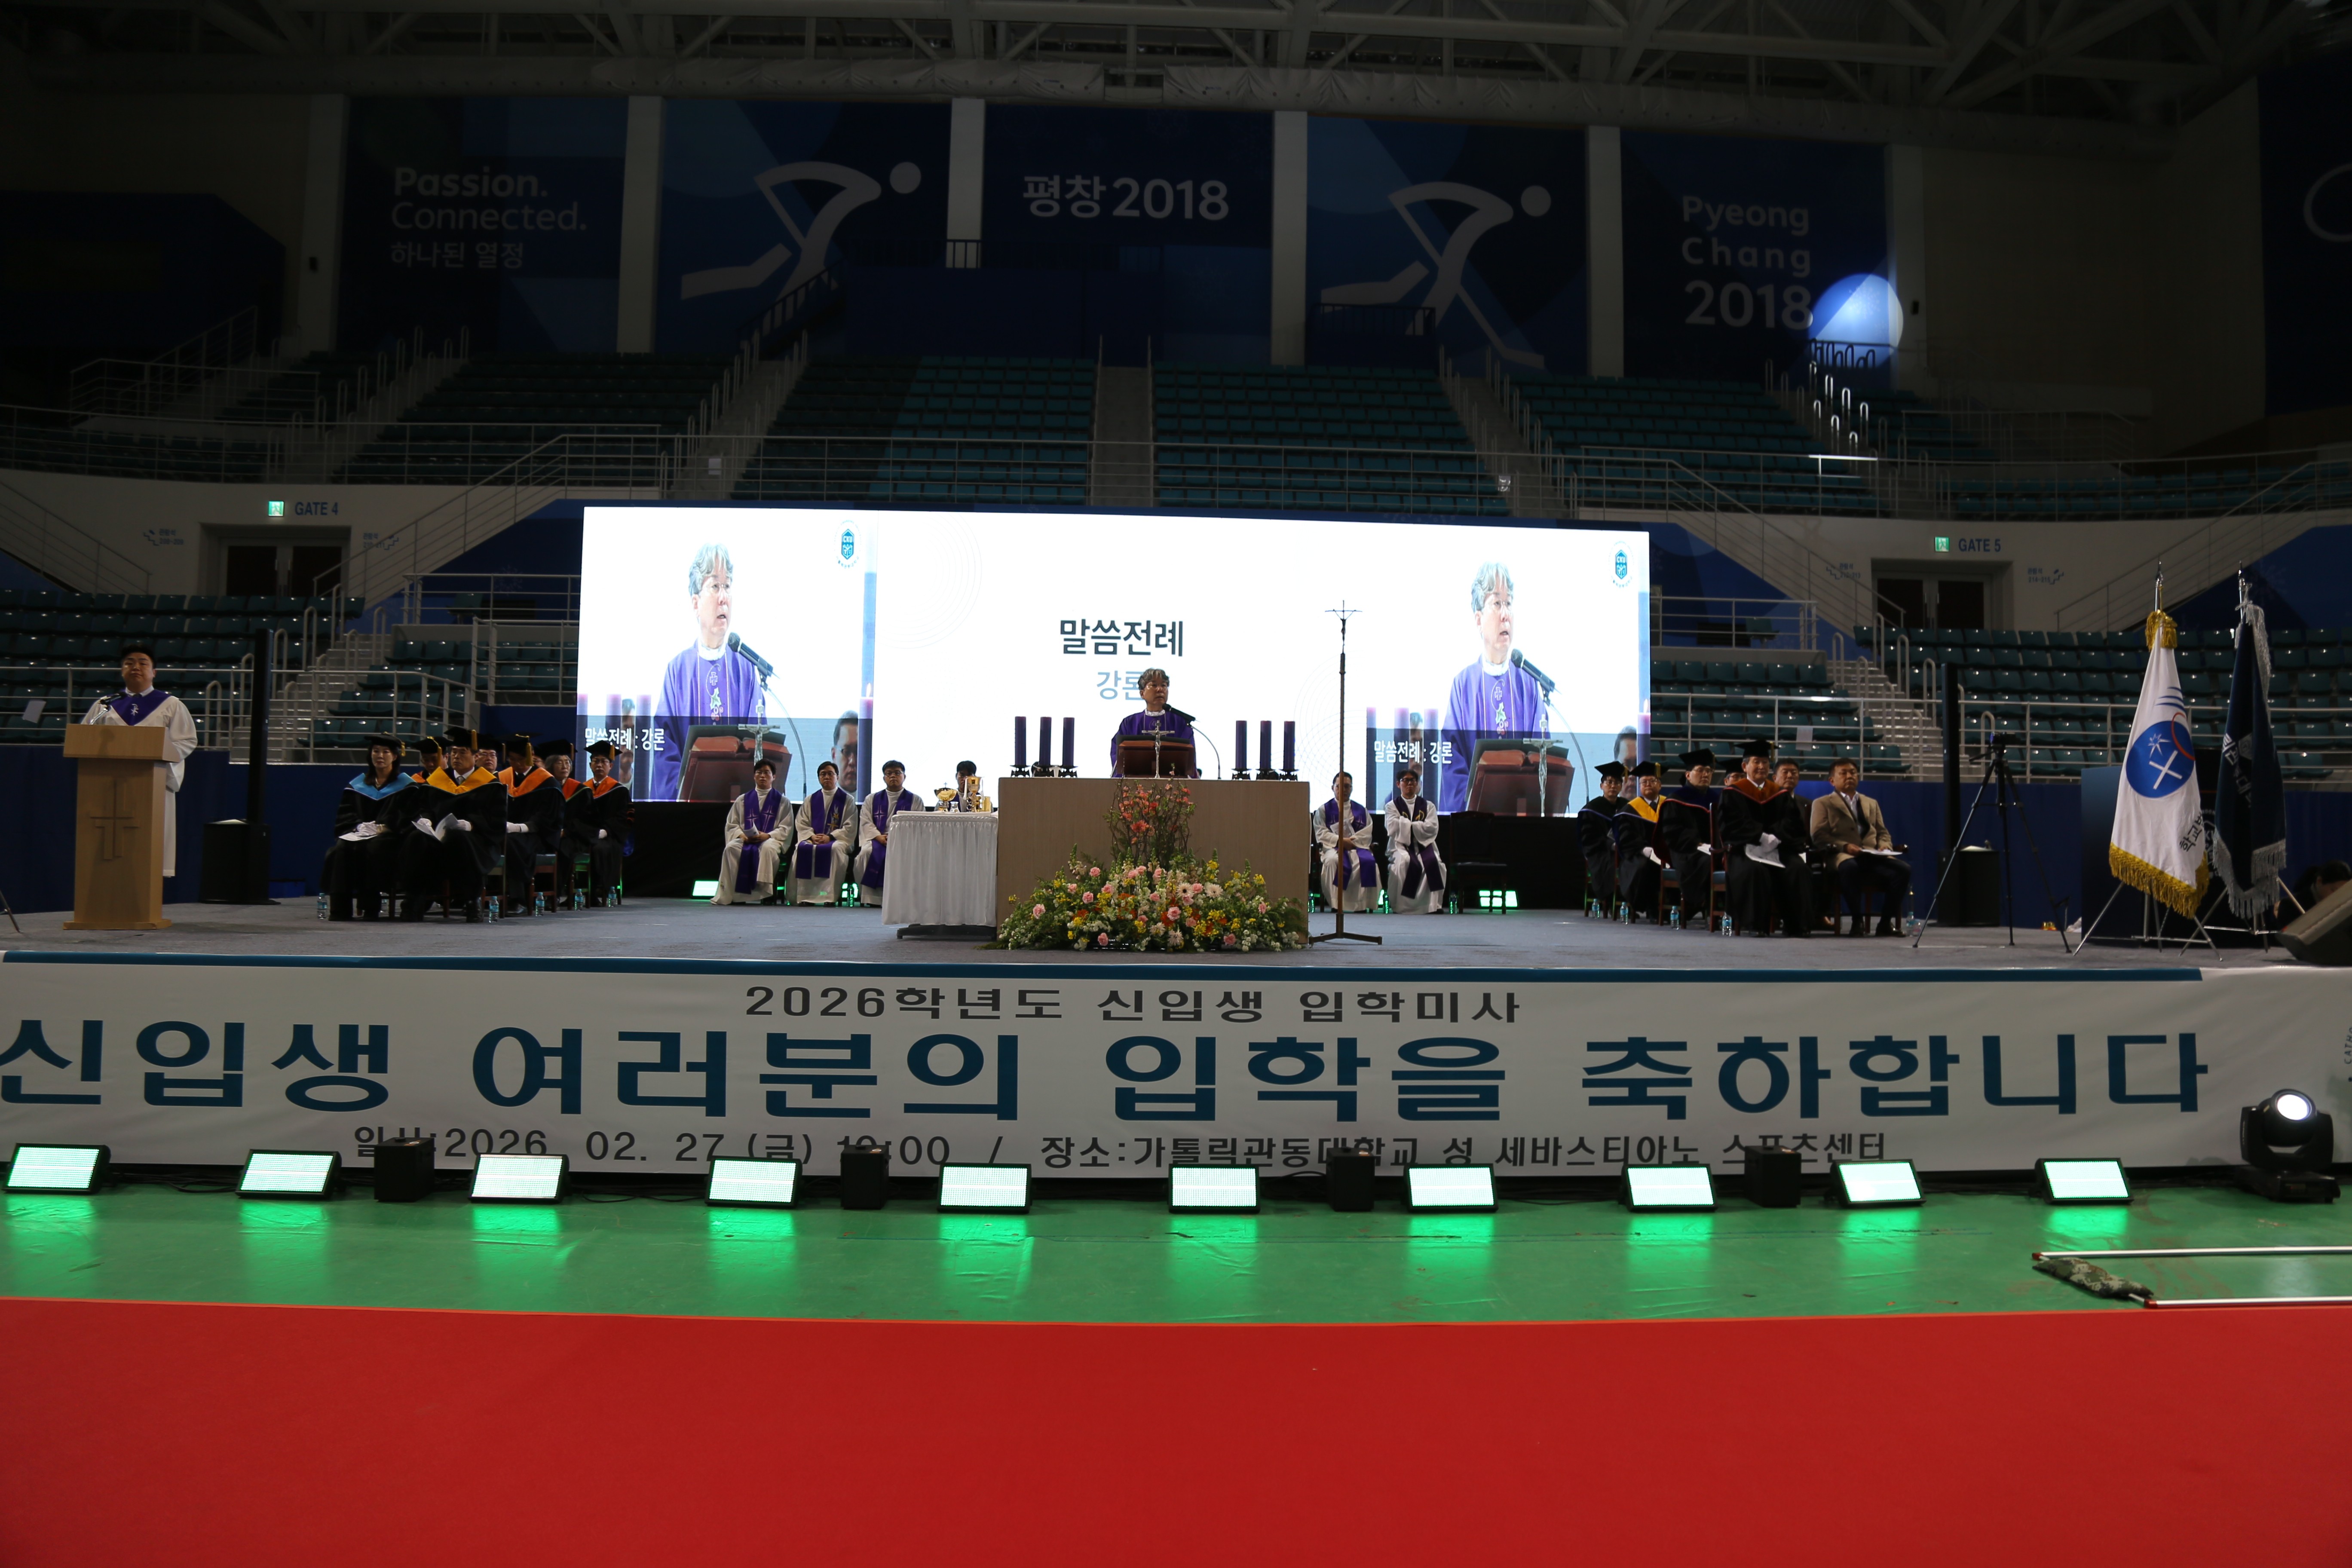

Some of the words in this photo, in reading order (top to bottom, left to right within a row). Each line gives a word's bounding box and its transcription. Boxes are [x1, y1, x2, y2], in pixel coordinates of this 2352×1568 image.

[395, 165, 548, 197] Passion.
[1023, 175, 1106, 218] 평창
[1112, 177, 1229, 220] 2018
[392, 200, 587, 230] Connected.
[1682, 196, 1809, 236] Pyeong
[390, 241, 465, 268] 하나된
[475, 242, 524, 269] 열정
[1681, 237, 1811, 278] Chang
[1684, 280, 1813, 330] 2018
[295, 502, 328, 515] GATE
[332, 502, 338, 515] 4
[1958, 538, 1990, 552] GATE
[1994, 539, 2001, 552] 5
[1060, 619, 1183, 657] 말씀전례
[641, 728, 665, 751] 강론
[1374, 740, 1420, 763] 말씀전례
[1430, 741, 1453, 764] 강론
[746, 986, 1062, 1020] 2026학년도
[1097, 990, 1263, 1023] 신입생
[1300, 992, 1520, 1023] 입학미사
[0, 1020, 389, 1112] 신입생
[472, 1027, 1018, 1121] 여러분의
[1106, 1035, 1506, 1122] 입학을
[1582, 1032, 2208, 1120] 축하합니다
[586, 1131, 646, 1161] 02.
[675, 1133, 725, 1161] 27
[1442, 1137, 1473, 1164] 성
[1494, 1136, 1700, 1167] 세바스티아노
